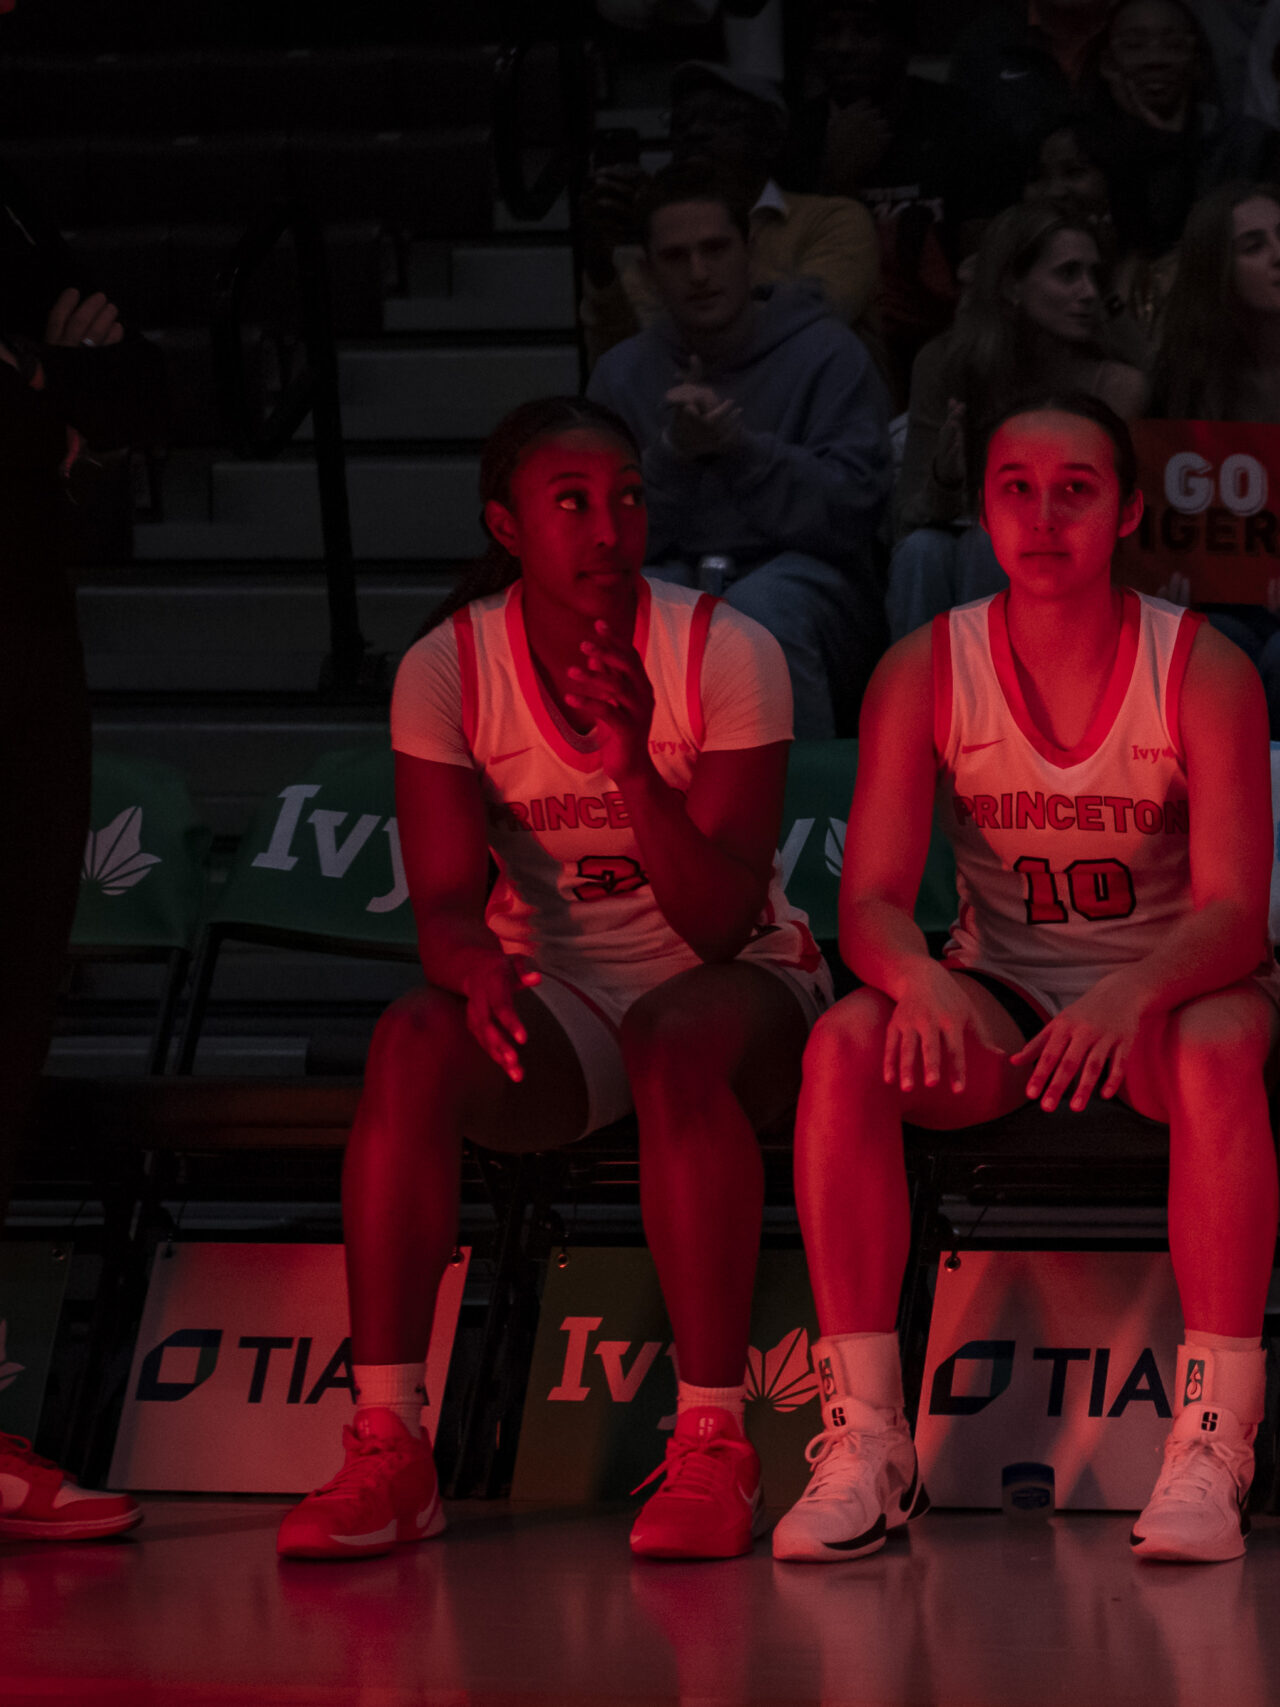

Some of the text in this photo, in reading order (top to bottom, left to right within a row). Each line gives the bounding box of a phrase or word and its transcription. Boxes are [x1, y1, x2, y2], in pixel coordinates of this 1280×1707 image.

[1164, 451, 1269, 516] GO
[1132, 745, 1160, 763] Ivy
[488, 791, 634, 832] PRINCE
[954, 791, 1190, 835] PRINCETON
[1014, 856, 1136, 924] 10
[238, 1337, 430, 1405] TIA
[1033, 1348, 1173, 1418] TIA
